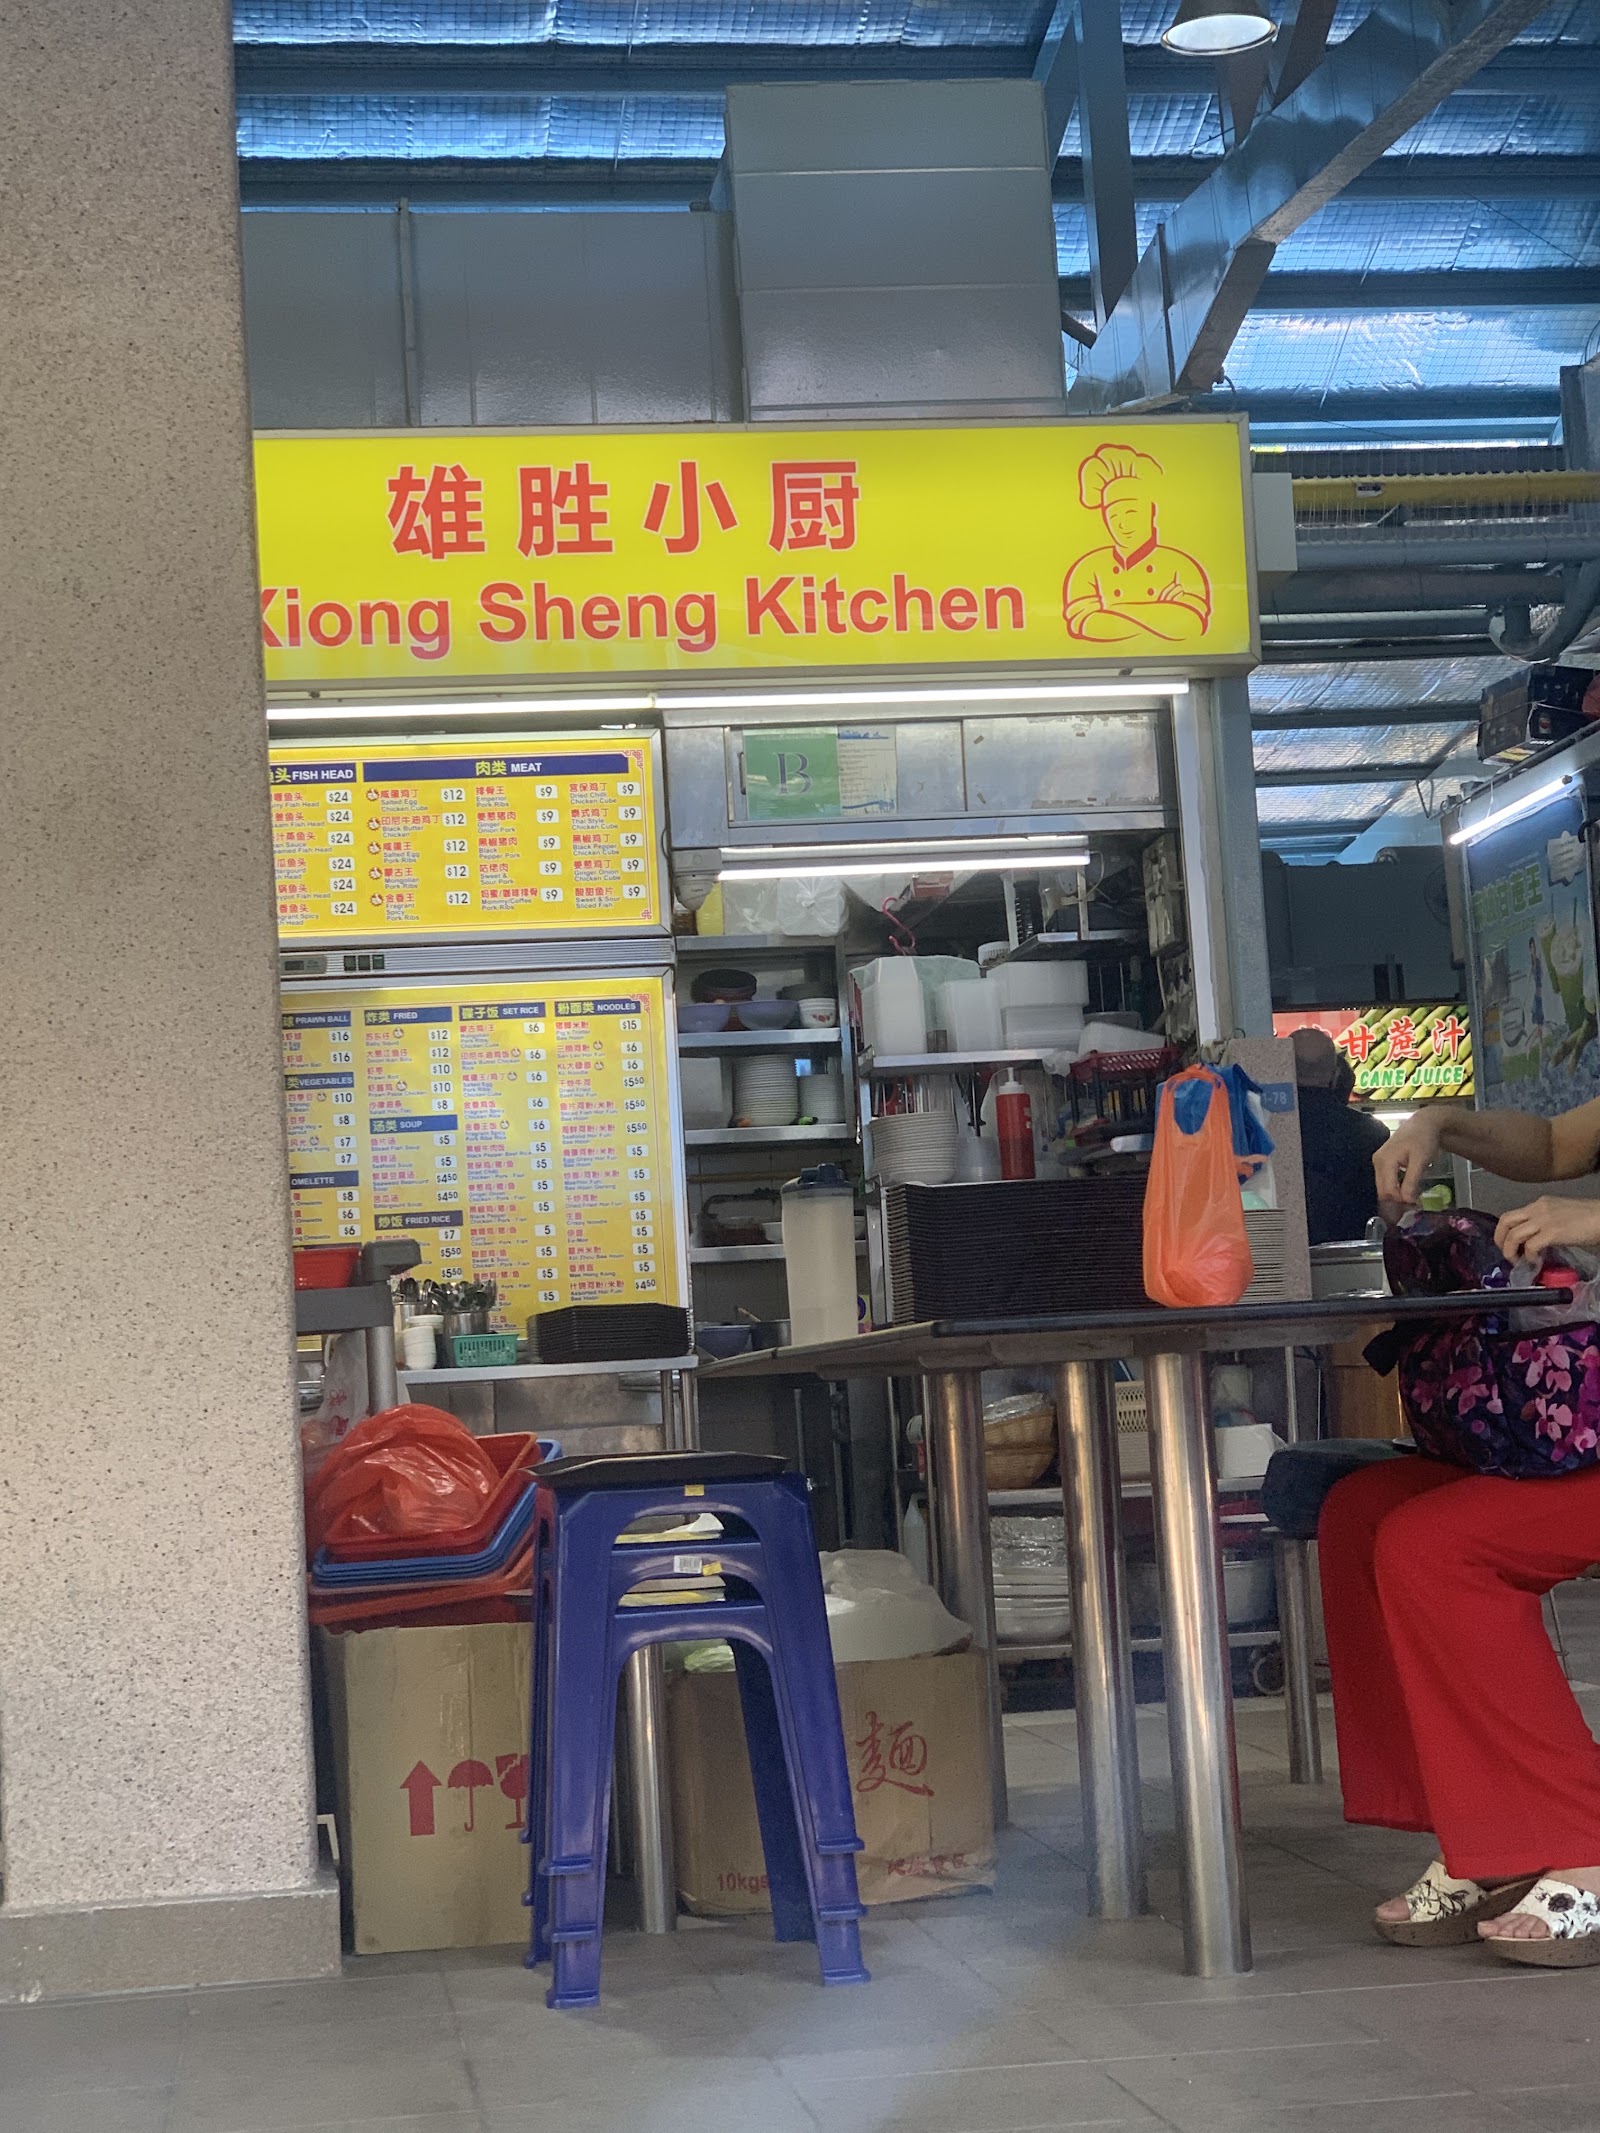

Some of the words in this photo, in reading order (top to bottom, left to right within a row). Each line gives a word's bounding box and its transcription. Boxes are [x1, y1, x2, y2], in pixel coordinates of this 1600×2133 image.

[387, 462, 859, 559] 雄胜小厨
[480, 582, 717, 653] Sheng
[745, 574, 1024, 636] Kitchen
[475, 761, 507, 776] 肉类
[511, 763, 542, 773] MEAT
[777, 752, 813, 795] B
[292, 771, 318, 781] FISH
[321, 769, 353, 780] HEAD
[443, 789, 463, 800] $12
[540, 786, 553, 797] $9
[622, 784, 635, 795] $9
[329, 792, 348, 803] $24
[330, 811, 350, 822] $24
[541, 811, 554, 822] $9
[624, 808, 636, 819] $9
[445, 814, 465, 825] $12
[331, 833, 351, 844] $24
[543, 837, 556, 848] $9
[625, 834, 637, 845] $9
[446, 840, 466, 851] $12
[332, 859, 352, 870] $24
[545, 862, 557, 873] $9
[627, 859, 639, 870] $9
[447, 866, 467, 877] $12
[333, 879, 353, 890] $24
[546, 889, 559, 900] $9
[628, 886, 641, 897] $9
[449, 893, 469, 904] $12
[334, 903, 354, 914] $24
[502, 1008, 518, 1016] SET
[520, 1006, 539, 1015] RICE
[597, 1002, 637, 1012] NOODLES
[295, 1016, 325, 1024] PRAWN
[327, 1015, 349, 1023] BALL
[393, 1012, 418, 1020] FRIED
[529, 1022, 540, 1032] $6
[622, 1020, 637, 1030] $15
[331, 1032, 350, 1041] $16
[431, 1030, 449, 1040] $12
[1338, 1017, 1465, 1065] 甘蔗汁
[627, 1042, 637, 1052] $6
[333, 1053, 351, 1062] $16
[431, 1048, 450, 1058] $12
[530, 1050, 541, 1060] $6
[432, 1064, 451, 1074] $10
[627, 1060, 638, 1070] $6
[299, 1077, 353, 1086] VEGETABLES
[531, 1072, 542, 1082] $6
[1359, 1070, 1405, 1088] CANE
[1411, 1068, 1463, 1086] JUICE
[433, 1082, 452, 1092] $10
[334, 1093, 353, 1103] $10
[533, 1098, 543, 1108] $6
[437, 1100, 448, 1110] $8
[339, 1115, 350, 1125] $8
[400, 1121, 423, 1129] SOUP
[534, 1121, 545, 1130] $6
[340, 1137, 351, 1147] $7
[439, 1135, 451, 1145] $5
[535, 1143, 546, 1152] $5
[632, 1146, 643, 1155] $5
[341, 1154, 352, 1164] $7
[441, 1157, 452, 1167] $5
[536, 1160, 547, 1169] $5
[634, 1170, 645, 1178] $5
[291, 1177, 335, 1186] OMELETTE
[538, 1181, 548, 1190] $5
[342, 1192, 354, 1201] $8
[635, 1192, 645, 1201] $5
[539, 1202, 549, 1212] $5
[342, 1209, 354, 1219] $6
[635, 1210, 646, 1219] $5
[405, 1217, 430, 1225] FRIED
[431, 1215, 451, 1223] RICE
[344, 1226, 356, 1236] $6
[445, 1230, 455, 1240] $7
[637, 1227, 647, 1236] $5
[541, 1247, 552, 1256] $5
[638, 1244, 648, 1253] $5
[639, 1262, 649, 1271] $5
[542, 1269, 553, 1278] $5
[544, 1291, 554, 1300] $5
